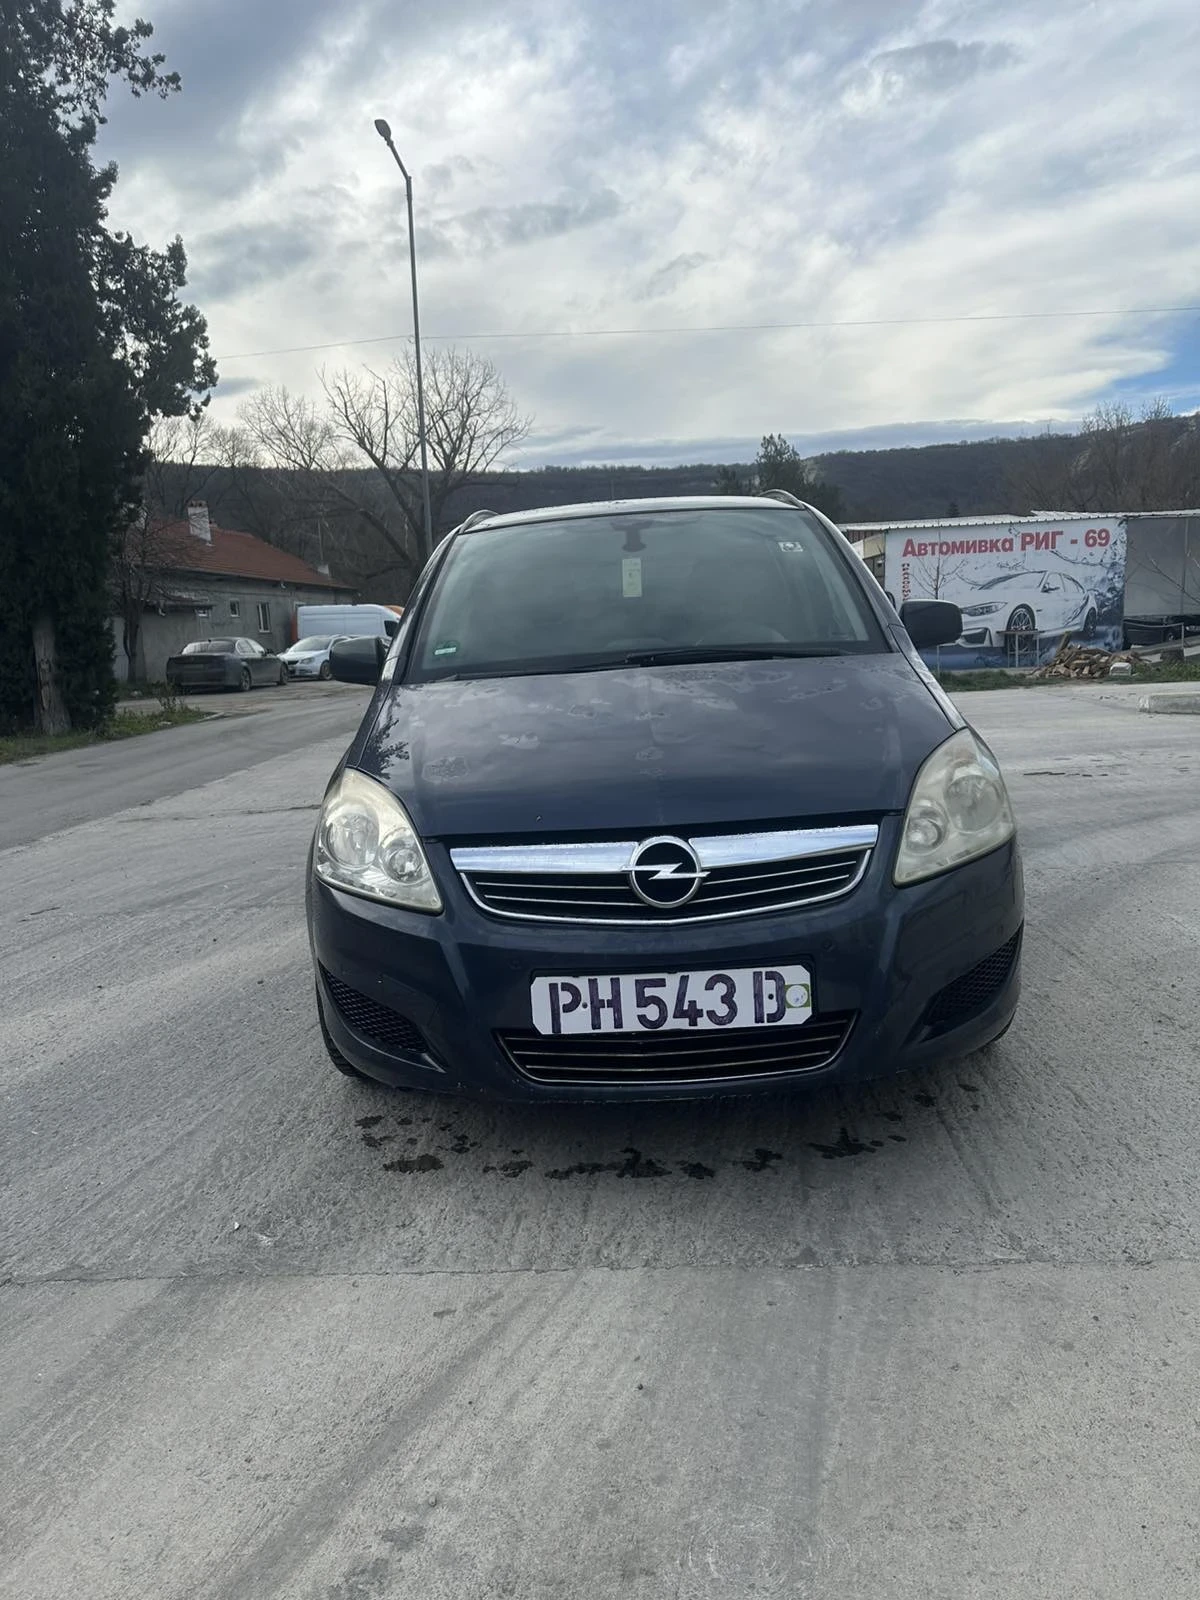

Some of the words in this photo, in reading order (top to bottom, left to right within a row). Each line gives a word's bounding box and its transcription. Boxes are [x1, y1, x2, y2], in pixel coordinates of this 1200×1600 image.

[902, 538, 1014, 557] Автомивка
[1020, 530, 1064, 551] РИГ
[1084, 528, 1111, 548] 69
